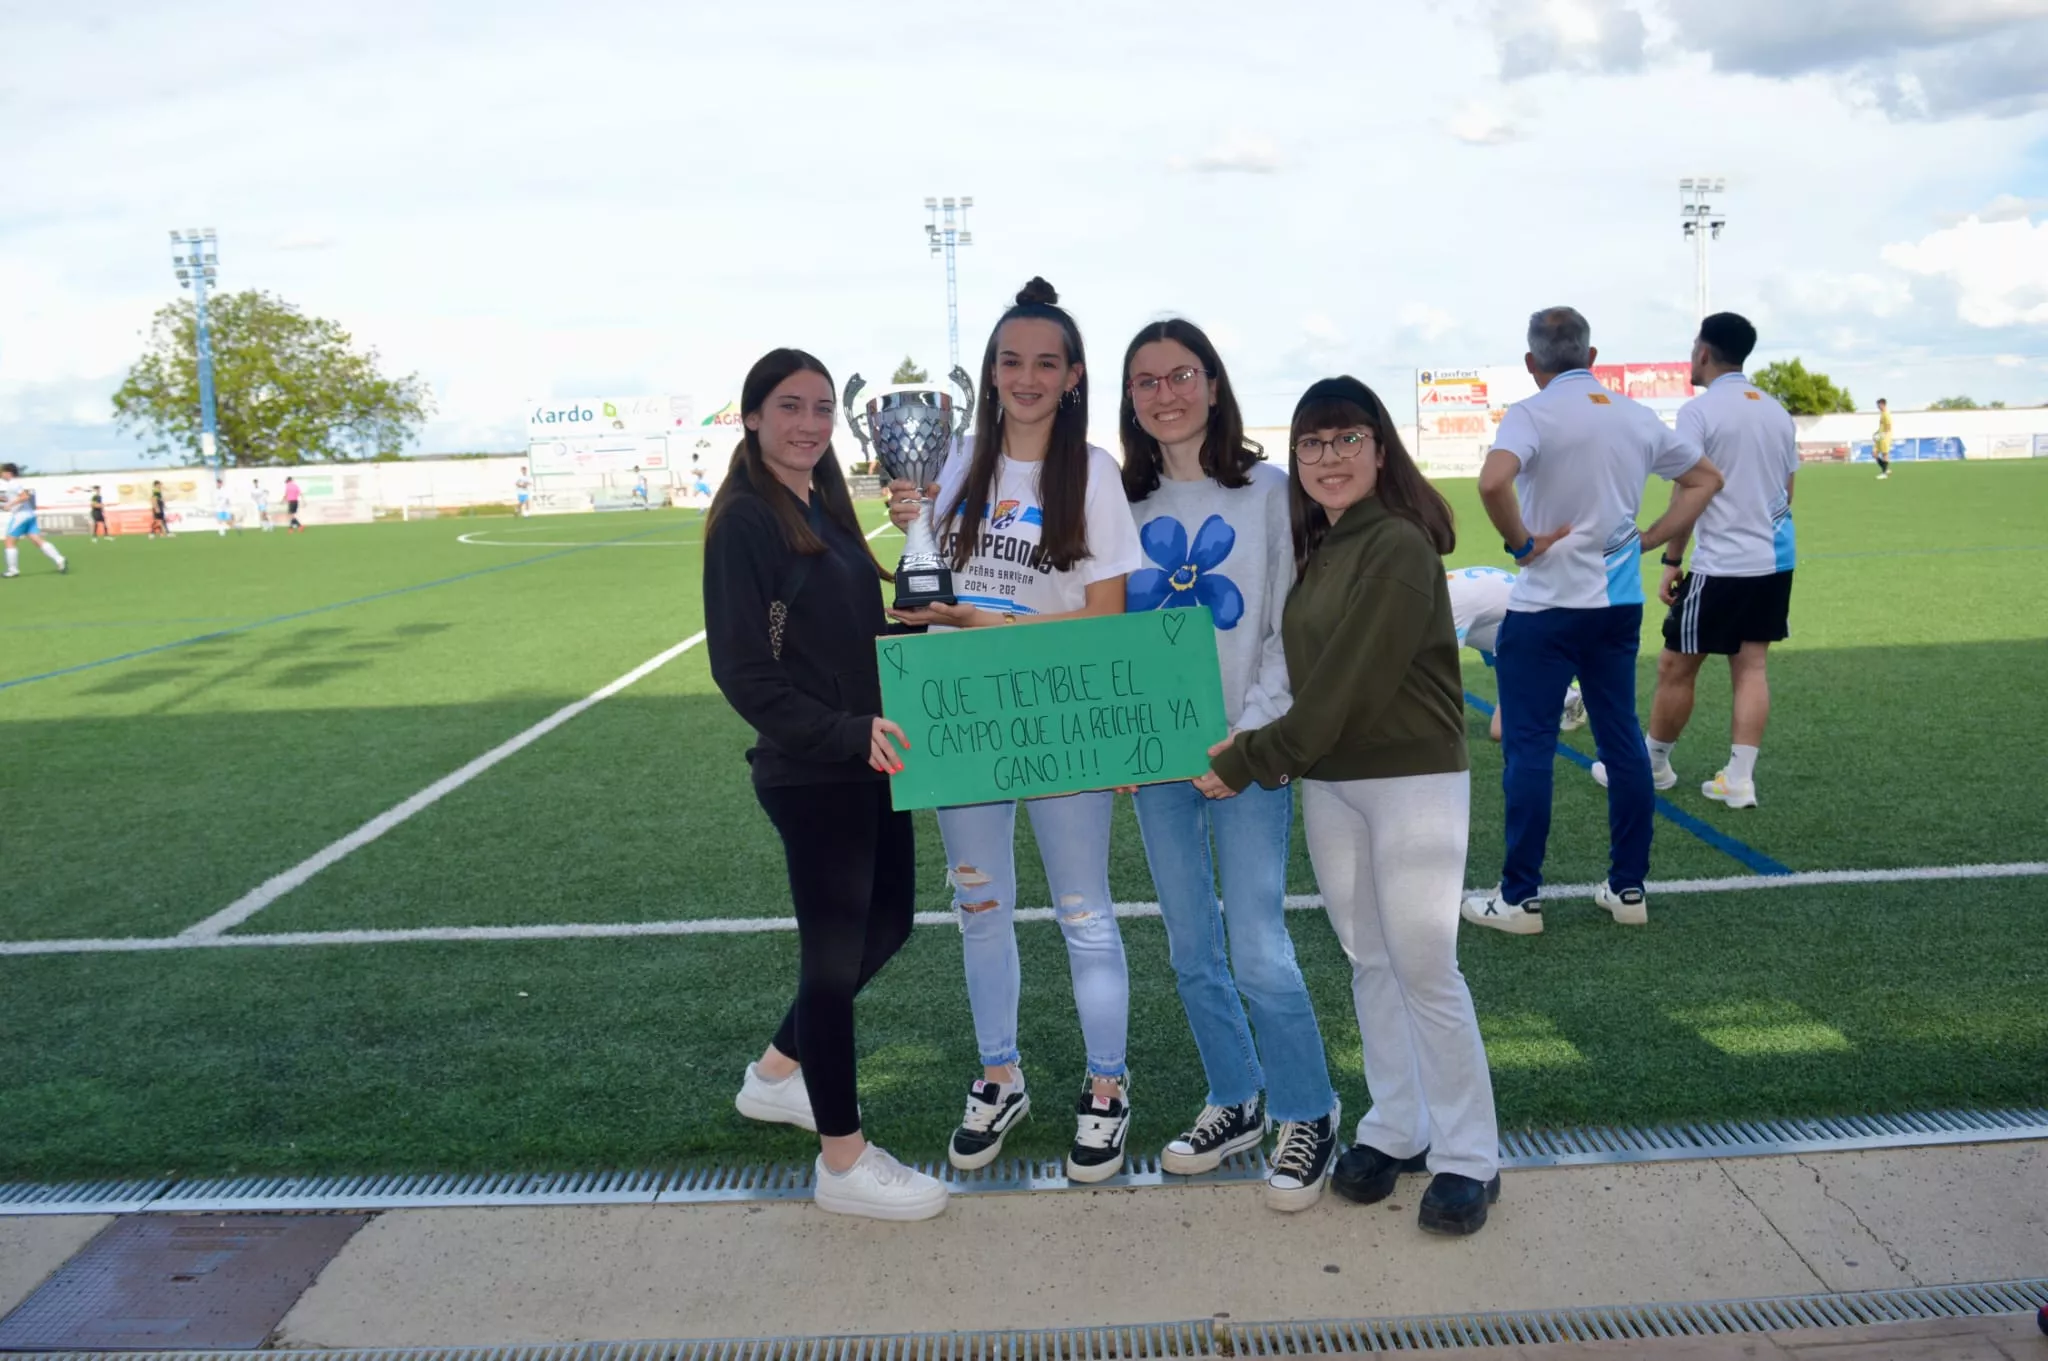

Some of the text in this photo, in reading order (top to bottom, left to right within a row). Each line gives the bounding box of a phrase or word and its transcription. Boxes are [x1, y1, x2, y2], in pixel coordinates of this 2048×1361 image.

[531, 404, 593, 424] Kardo
[964, 579, 988, 592] 2024
[969, 565, 995, 578] PEÑAS
[921, 660, 1145, 721] QUE TIEMBLE EL
[927, 698, 1200, 758] CAMPO QUE LA REICHEL YA
[1124, 736, 1164, 776] 10
